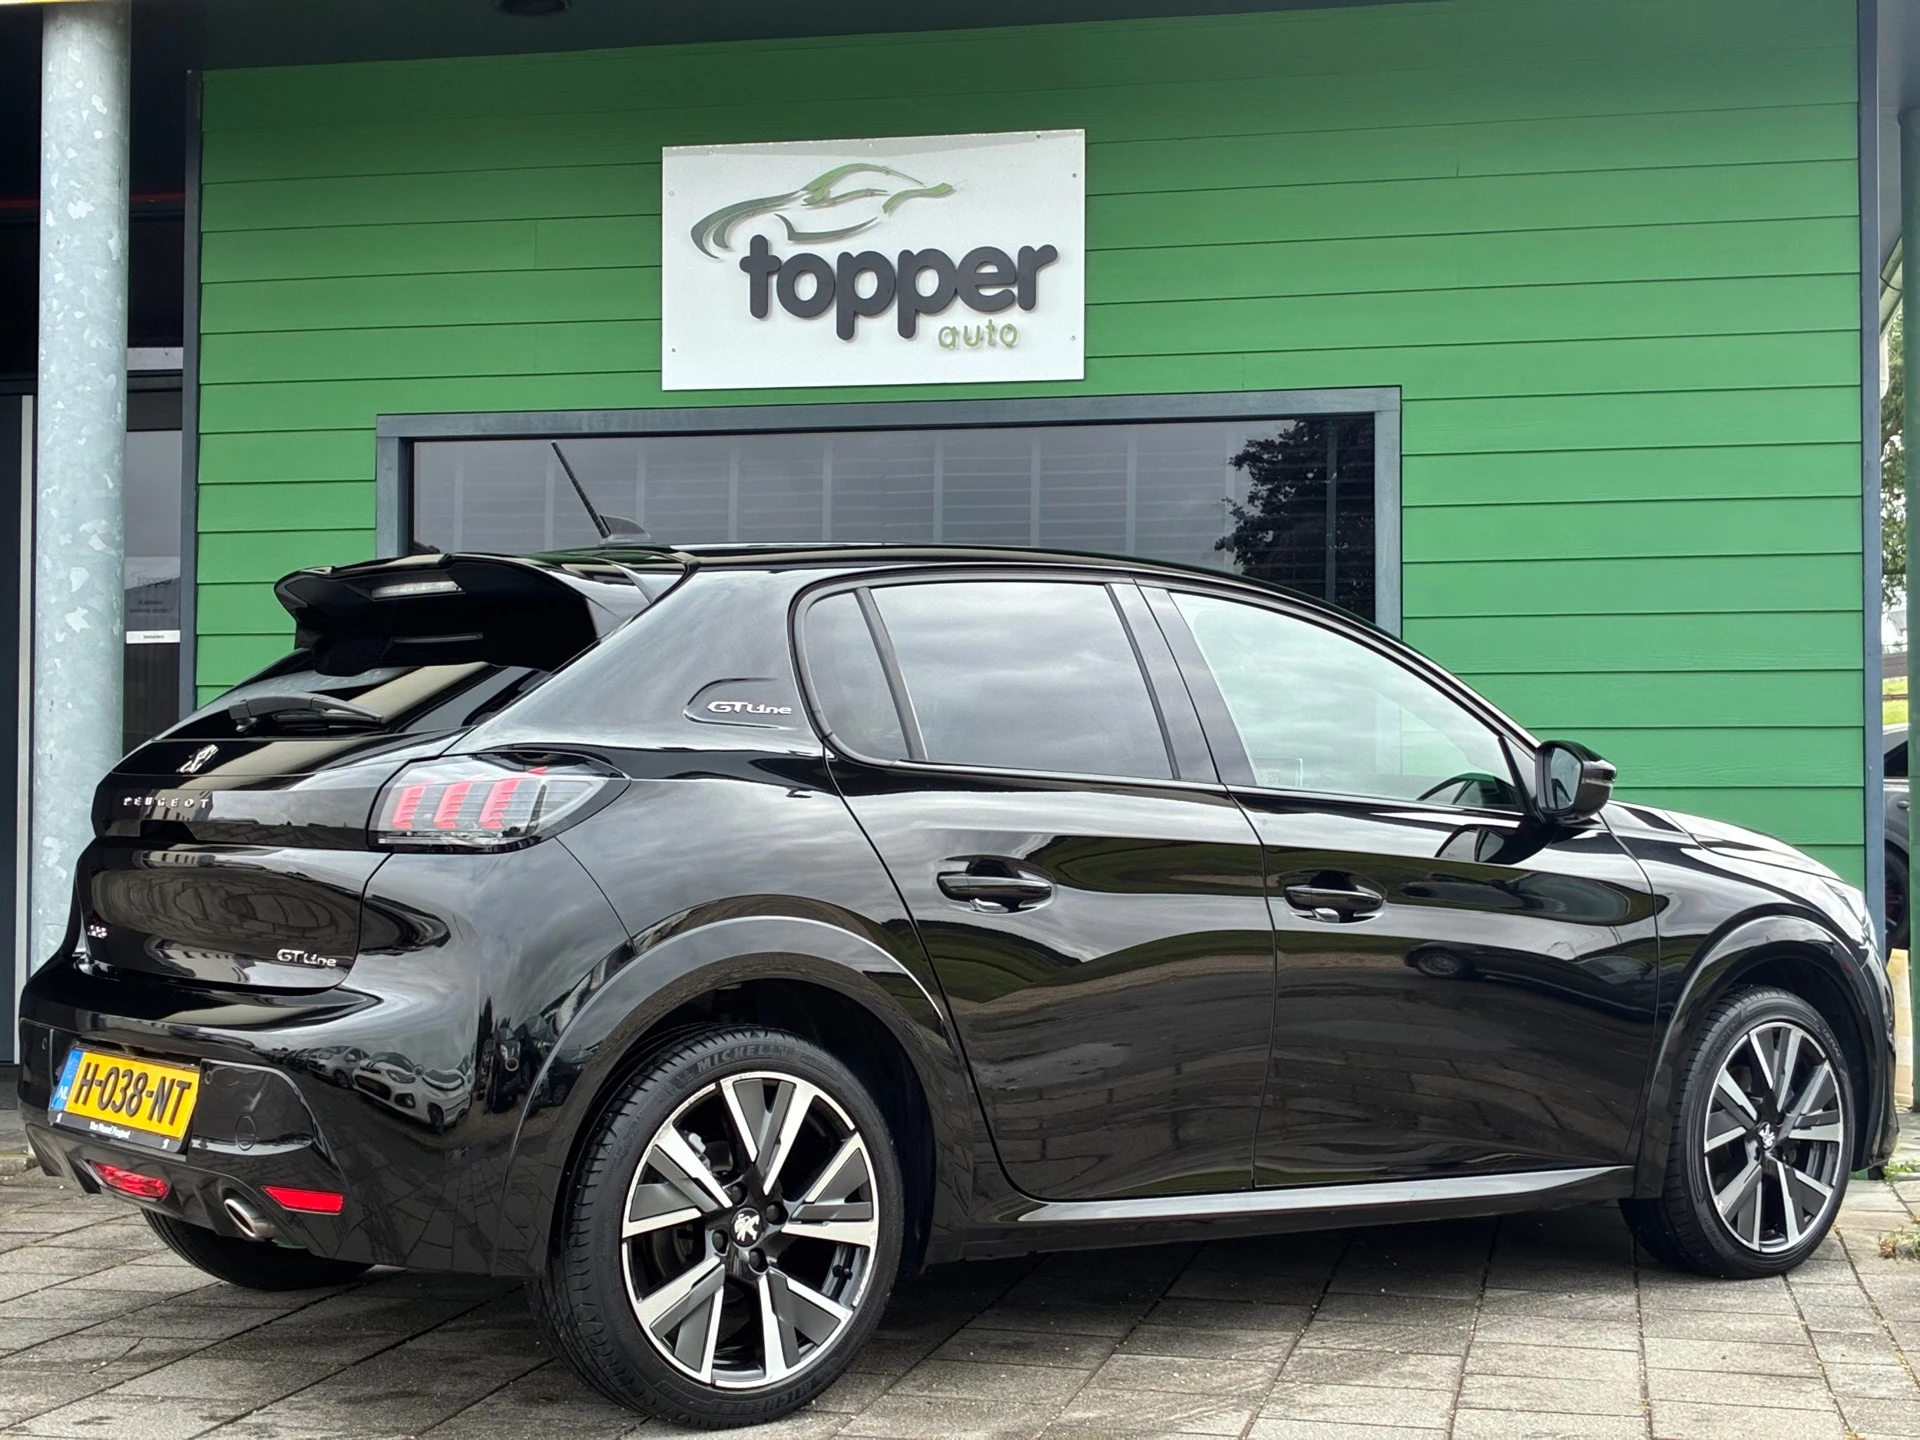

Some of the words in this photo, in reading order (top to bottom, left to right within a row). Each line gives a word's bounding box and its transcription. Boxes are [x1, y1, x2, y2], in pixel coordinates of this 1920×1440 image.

[739, 233, 1058, 341] topper
[937, 318, 1019, 349] auto
[707, 701, 748, 713] GT
[123, 796, 210, 809] PEUGEOT
[276, 948, 304, 963] GT
[73, 1062, 193, 1126] H-038-NT
